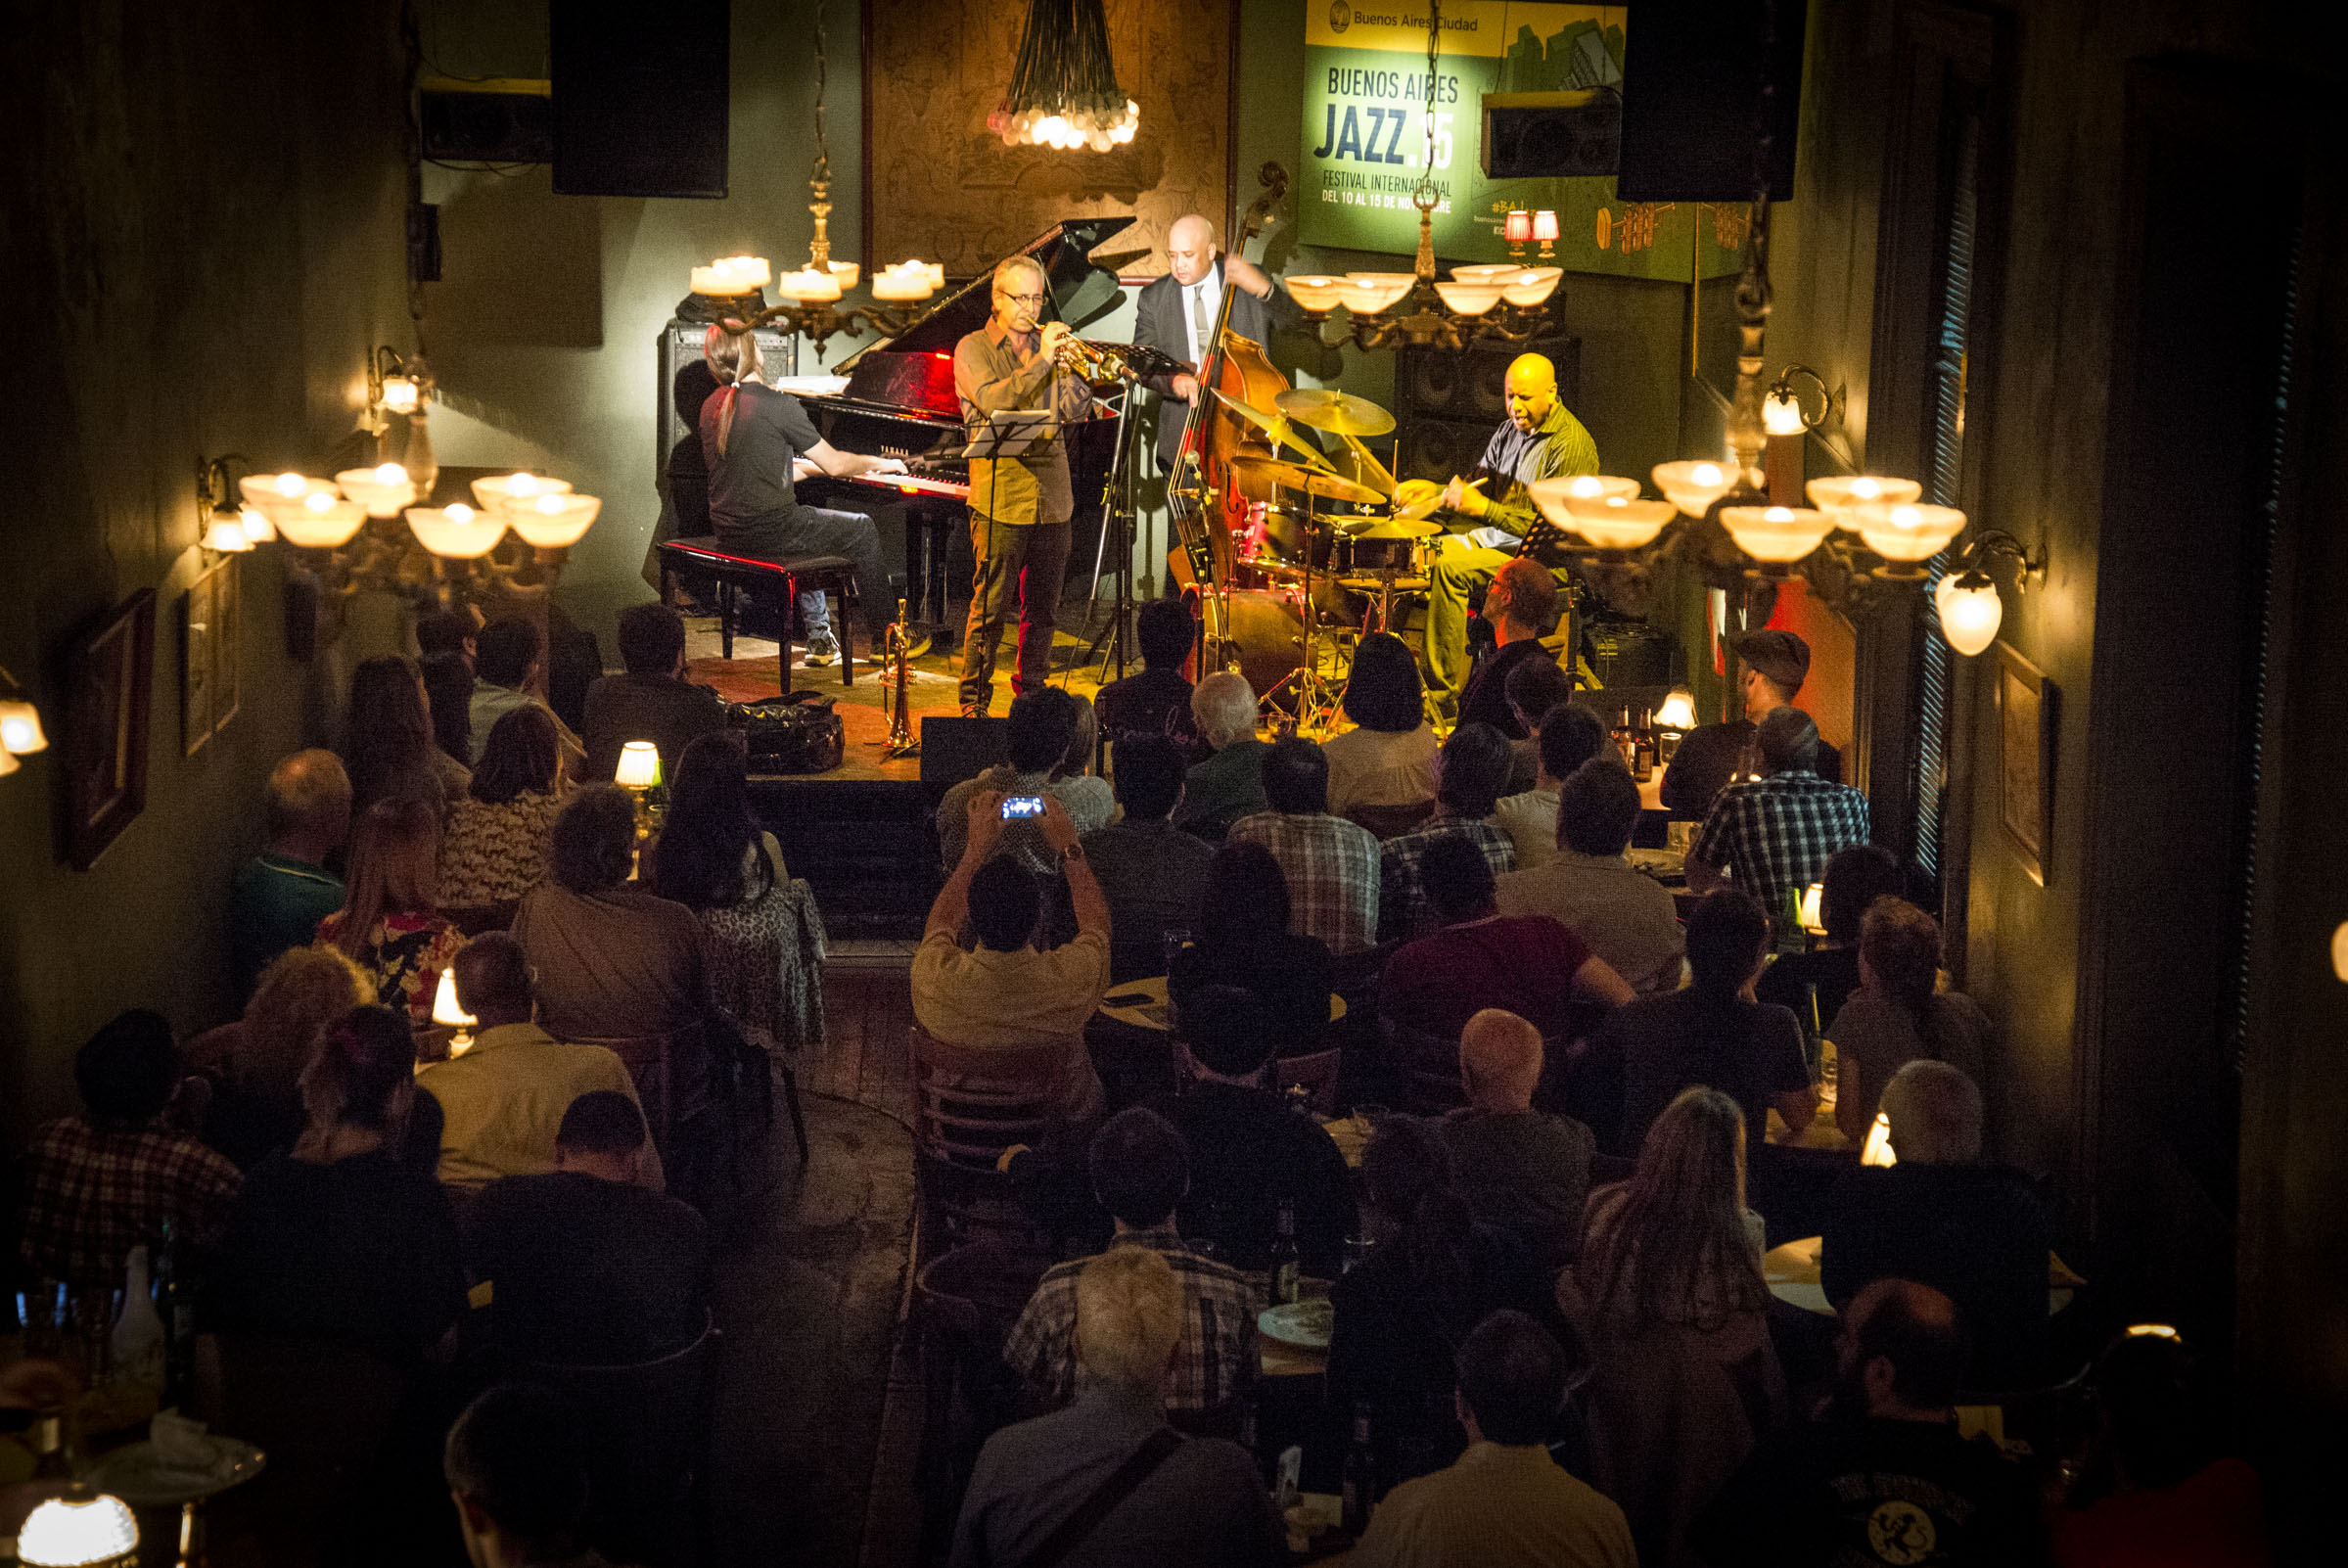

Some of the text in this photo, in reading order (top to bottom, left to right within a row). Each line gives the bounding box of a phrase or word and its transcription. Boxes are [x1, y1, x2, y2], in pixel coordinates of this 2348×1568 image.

[1355, 12, 1478, 31] Buenos Aires Ciudad
[1327, 67, 1458, 104] BUENOS AIRES
[1323, 169, 1451, 198] FESTIVAL INTERNACIONAL
[1322, 189, 1338, 203] DEL
[1342, 191, 1354, 205] 10
[1356, 193, 1367, 207] AL
[1369, 195, 1381, 208] 15
[1383, 196, 1396, 208] DE
